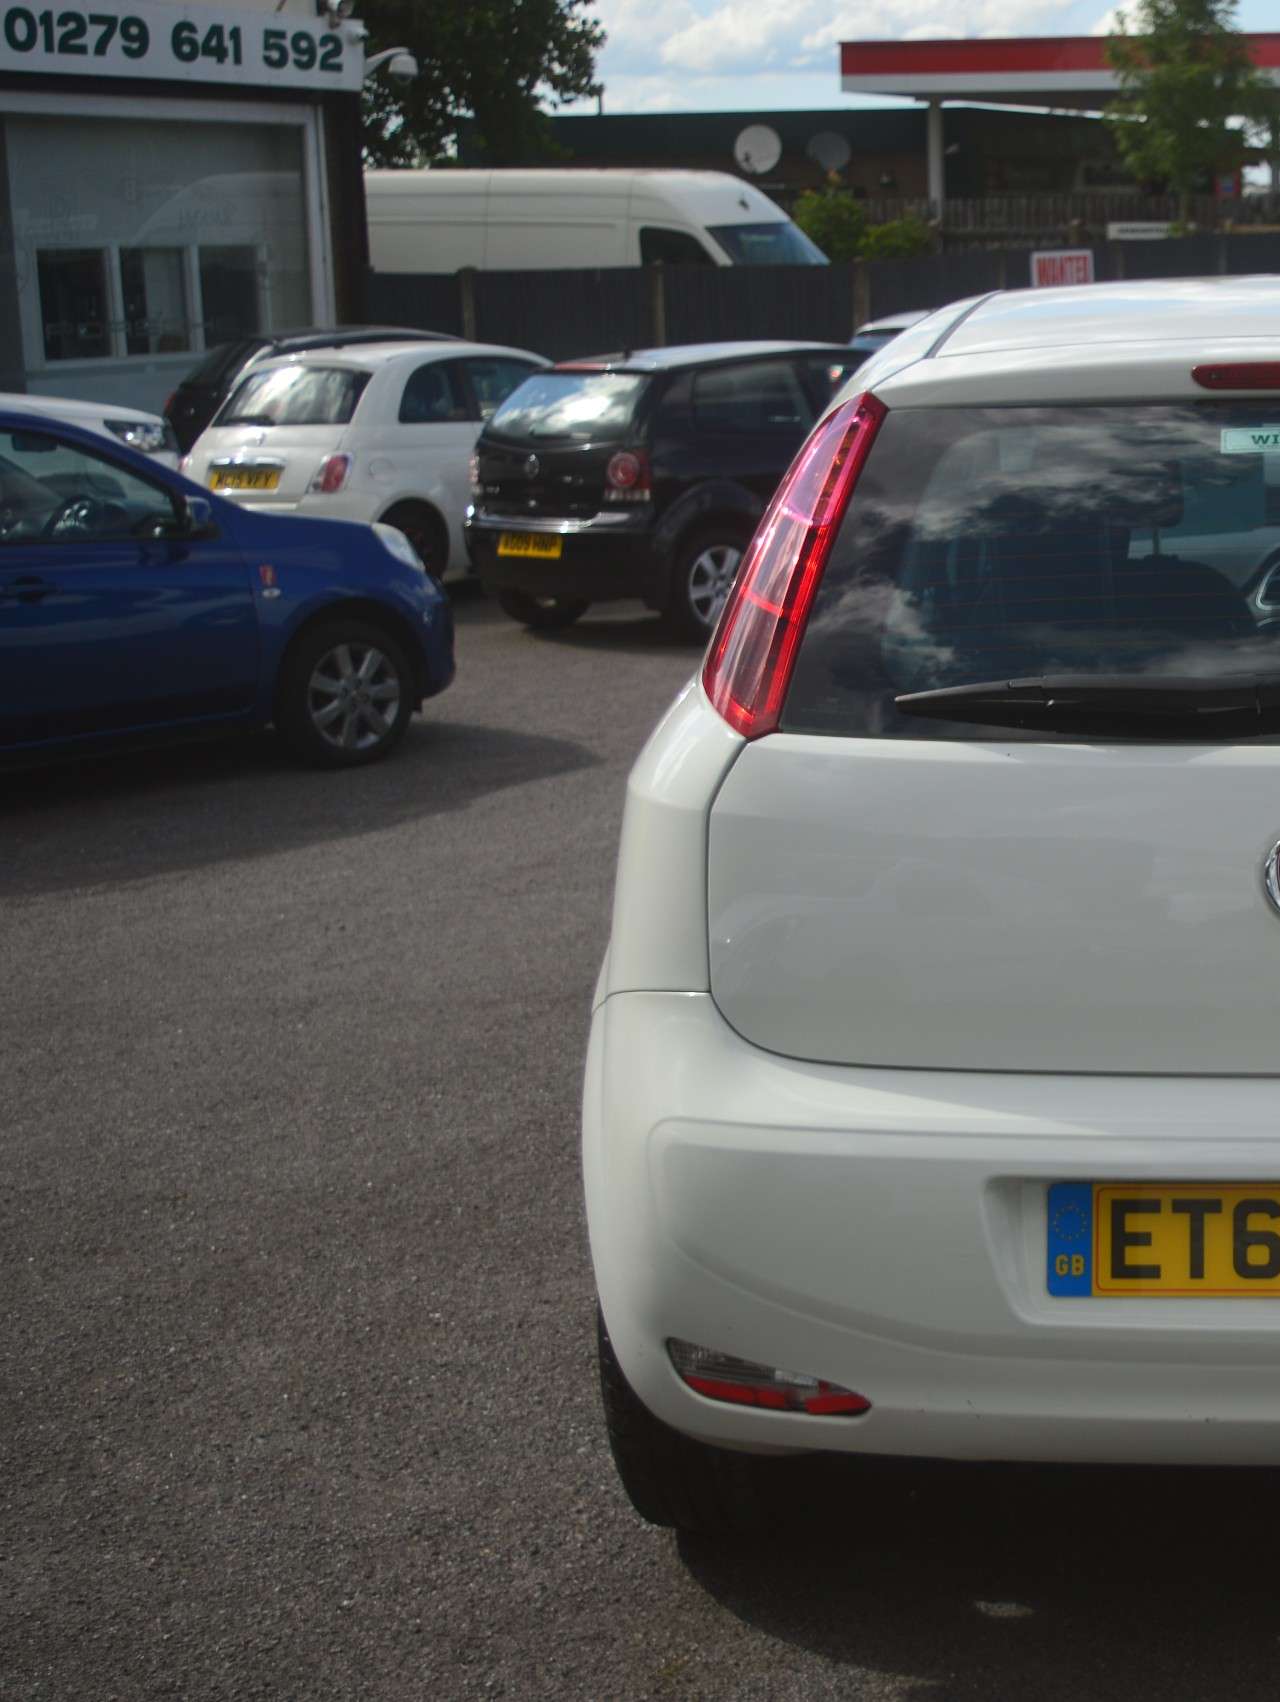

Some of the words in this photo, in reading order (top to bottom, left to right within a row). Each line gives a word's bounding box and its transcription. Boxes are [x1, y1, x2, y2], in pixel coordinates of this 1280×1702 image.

[4, 7, 150, 59] 01279
[171, 21, 242, 65] 641
[263, 28, 344, 72] 592
[1055, 1253, 1084, 1277] GB
